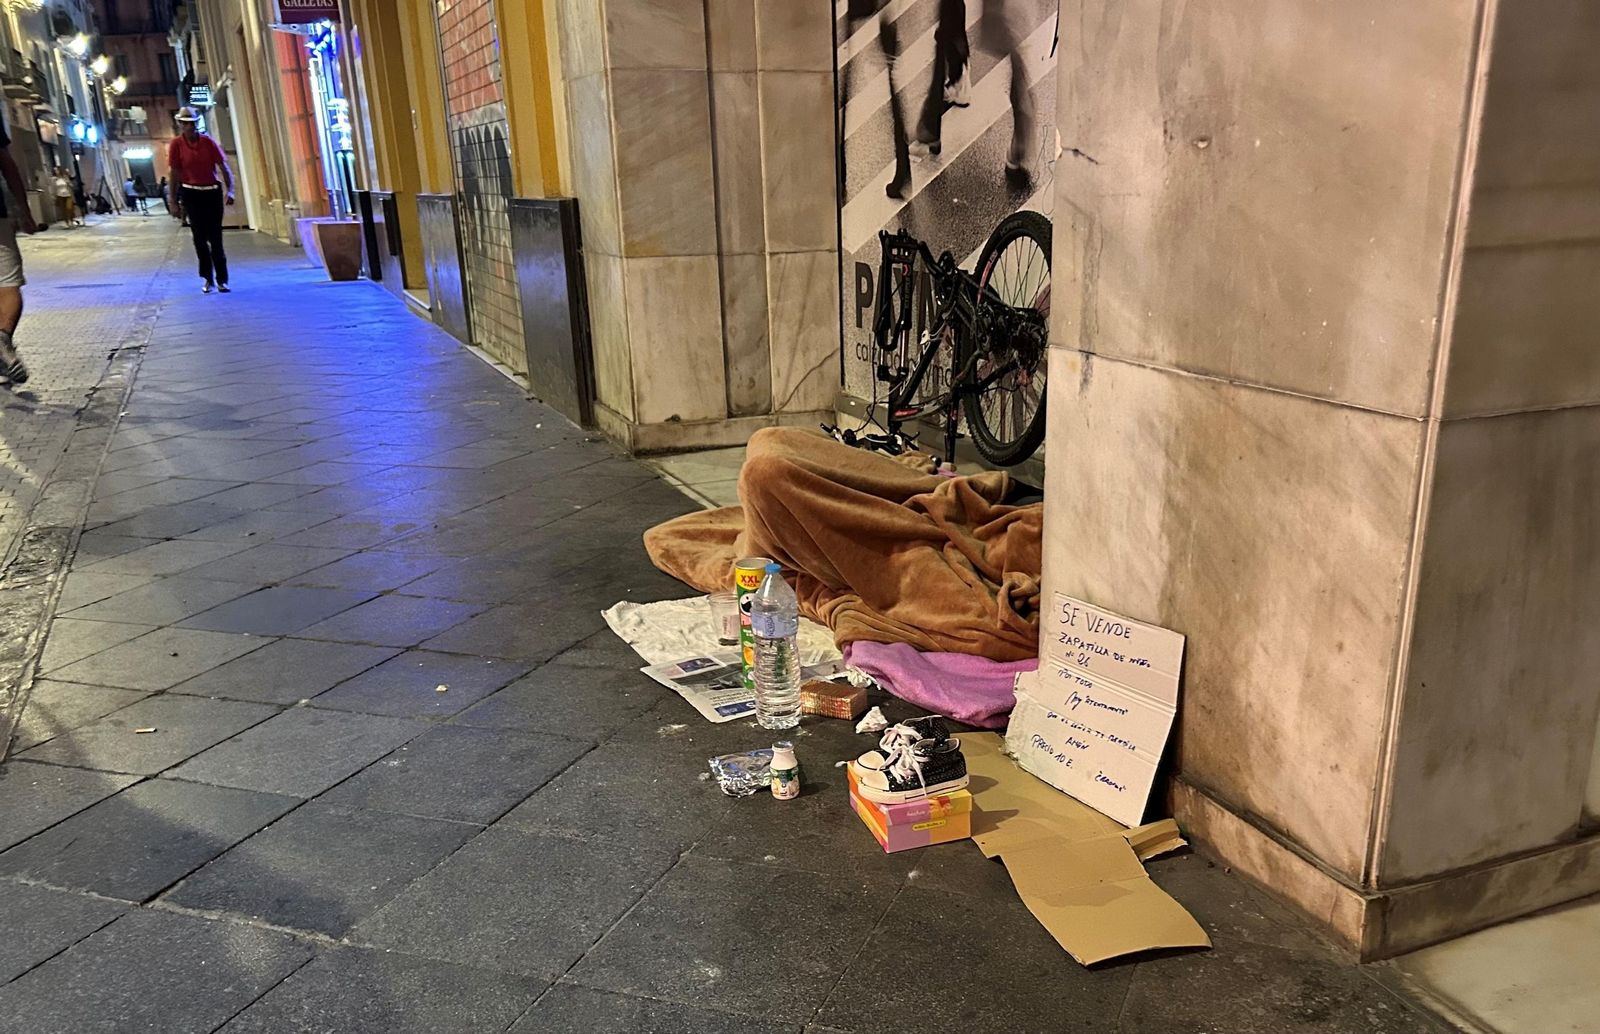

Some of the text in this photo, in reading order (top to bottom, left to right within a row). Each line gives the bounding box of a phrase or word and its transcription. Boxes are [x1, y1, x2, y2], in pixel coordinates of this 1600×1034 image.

[740, 575, 760, 583] XXL
[1060, 602, 1132, 639] SE VENDE
[1113, 652, 1126, 663] DE
[1031, 733, 1054, 755] PRECIO
[1054, 752, 1066, 763] 10
